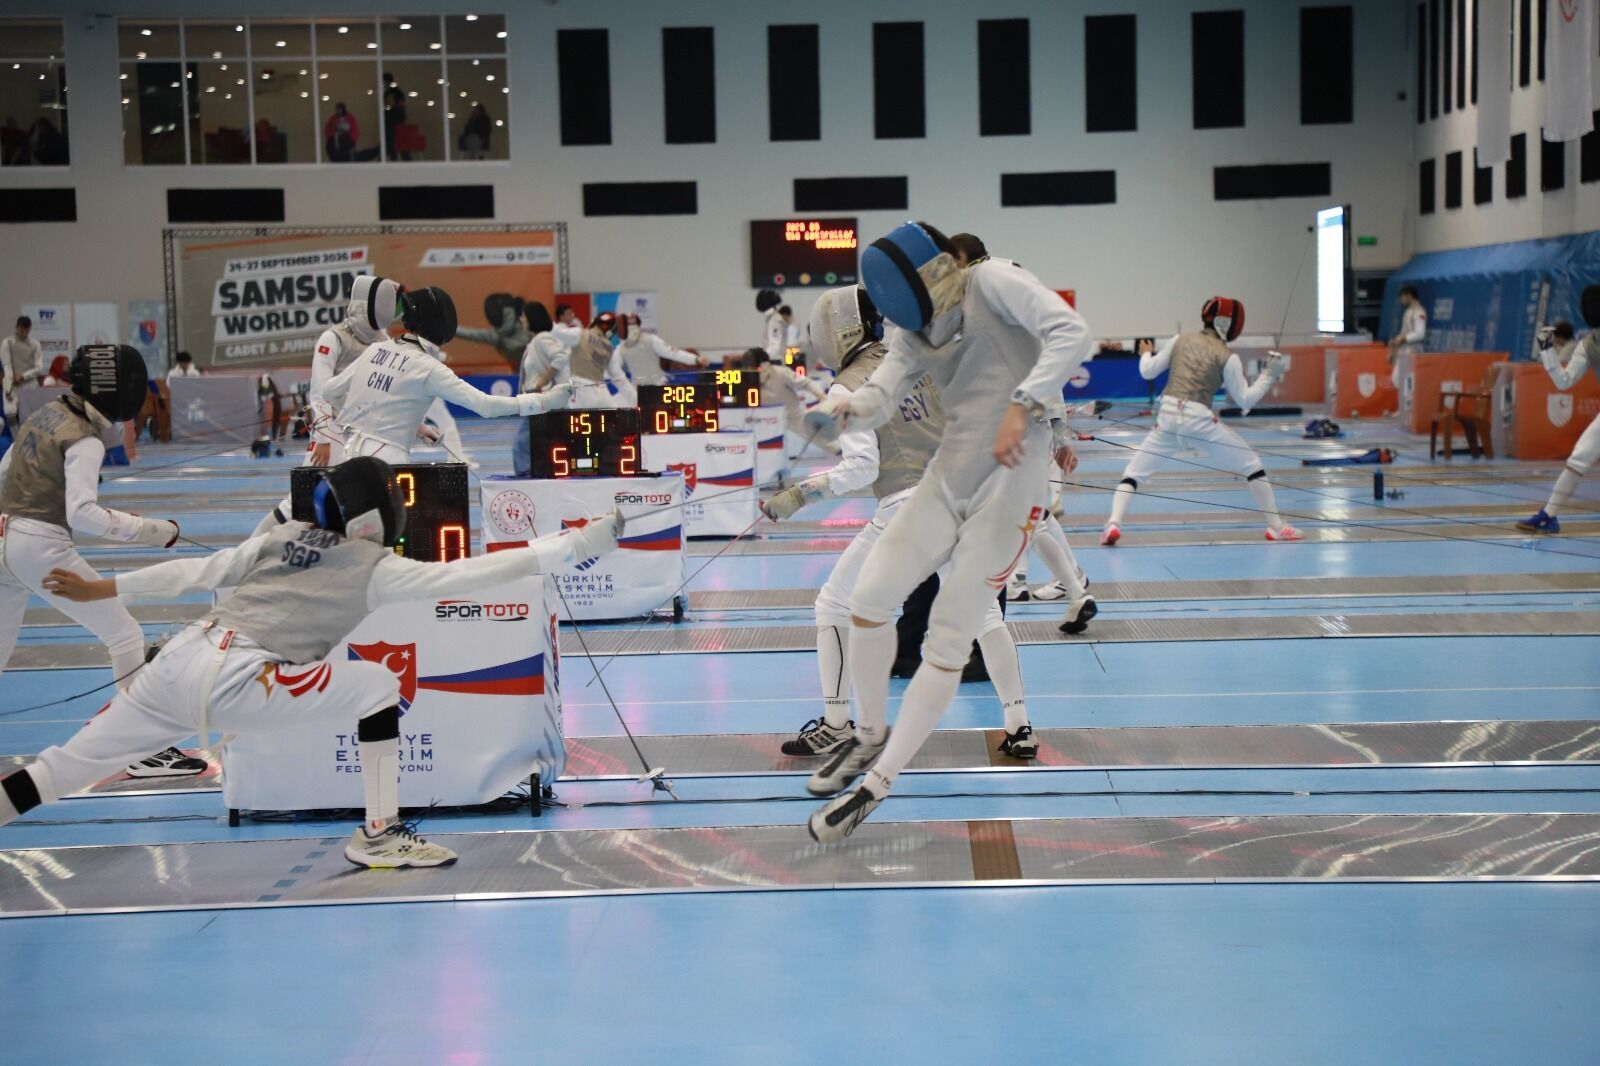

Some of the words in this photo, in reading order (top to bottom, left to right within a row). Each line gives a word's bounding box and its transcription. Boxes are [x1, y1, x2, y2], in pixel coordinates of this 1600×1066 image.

[261, 254, 321, 271] SEPTEMBER
[224, 308, 309, 335] WORLD
[315, 306, 348, 326] CU
[369, 348, 391, 366] ZOU
[367, 371, 394, 392] CHN
[715, 370, 741, 384] 3:00
[663, 386, 695, 403] 2:02
[899, 393, 930, 422] EGY
[655, 411, 668, 433] 0
[704, 410, 718, 432] 5
[553, 447, 569, 476] 5
[620, 445, 636, 474] 2
[282, 541, 321, 569] SGP
[336, 764, 433, 773] FEDYONU
